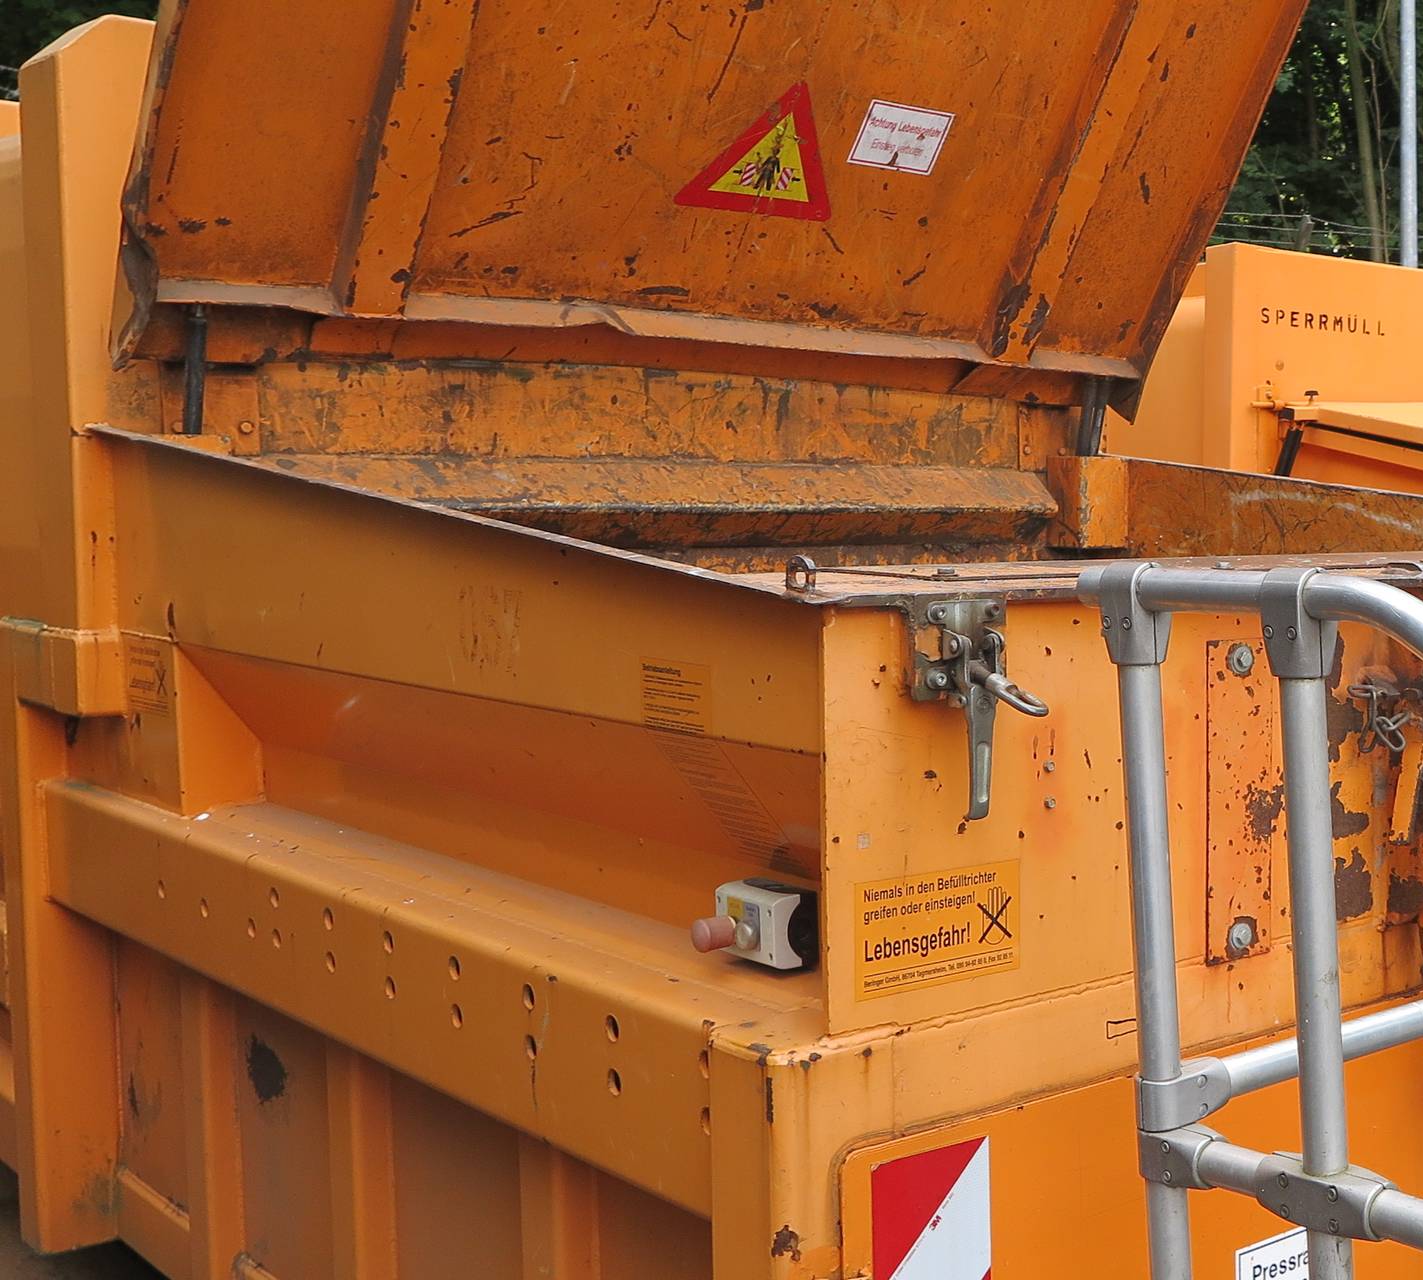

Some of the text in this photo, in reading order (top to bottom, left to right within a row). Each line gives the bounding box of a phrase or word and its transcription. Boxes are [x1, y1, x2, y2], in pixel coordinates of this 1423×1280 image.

[870, 116, 942, 138] Achtung Lebensgefahr
[1260, 307, 1385, 336] SPERRMÜLL
[864, 872, 997, 903] Niemals in den Befülltrichter
[864, 891, 976, 925] greifen oder einsteigen!
[864, 921, 971, 962] Lebensgefahr!
[929, 1215, 942, 1231] 3M
